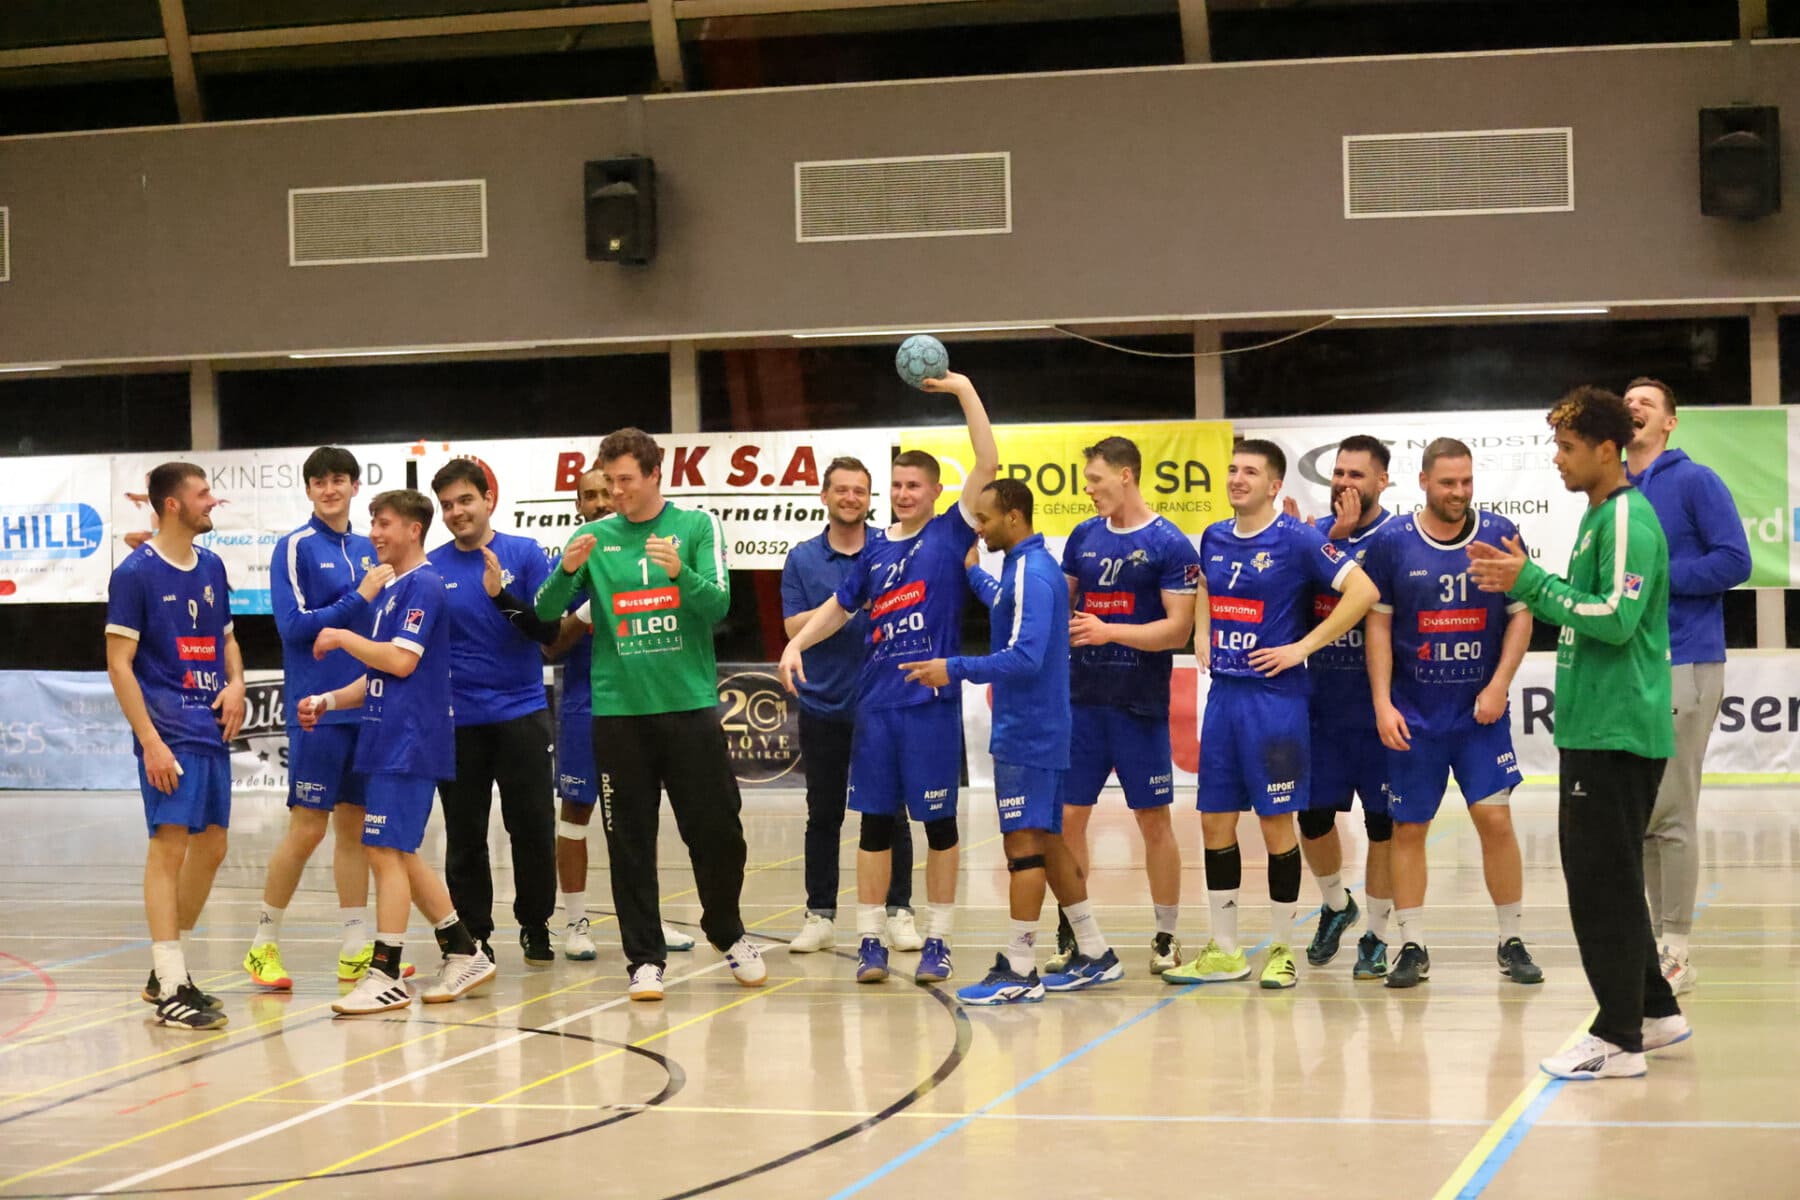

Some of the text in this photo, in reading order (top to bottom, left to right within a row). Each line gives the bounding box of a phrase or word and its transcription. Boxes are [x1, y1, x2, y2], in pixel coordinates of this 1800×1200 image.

[725, 444, 820, 487] S.A
[1154, 459, 1212, 495] SA
[603, 545, 622, 553] JAKO
[734, 540, 789, 555] 00352
[637, 557, 649, 586] 1
[1227, 561, 1243, 590] 7
[1409, 569, 1428, 577] JAKO
[1438, 572, 1468, 603] 31
[1423, 616, 1480, 627] Dussmann
[1266, 780, 1295, 793] ASPORT
[1004, 810, 1022, 819] JAKO
